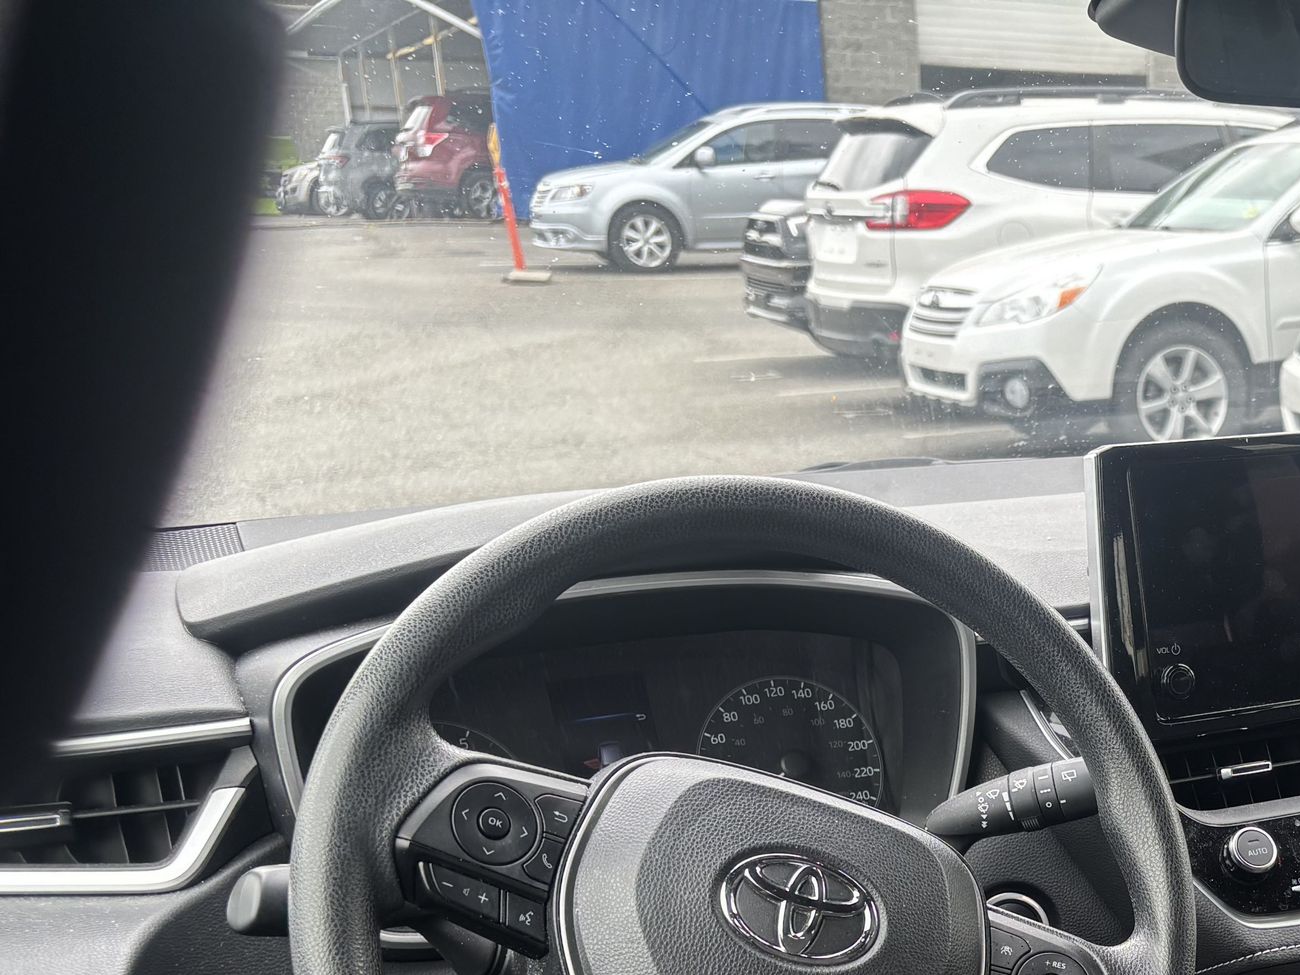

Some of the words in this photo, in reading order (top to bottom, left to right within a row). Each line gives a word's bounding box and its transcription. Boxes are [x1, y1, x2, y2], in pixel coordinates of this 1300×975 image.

[764, 686, 784, 698] 120
[792, 688, 812, 700] 140
[739, 694, 760, 705] 100
[814, 700, 835, 711] 160
[722, 712, 738, 723] 80
[834, 718, 854, 729] 180
[459, 738, 469, 748] 5
[710, 733, 726, 744] 60
[848, 741, 868, 752] 200
[854, 767, 874, 778] 220
[850, 790, 870, 801] 240
[488, 817, 503, 829] OK
[1248, 848, 1268, 857] AUTO
[1052, 961, 1066, 970] RES
